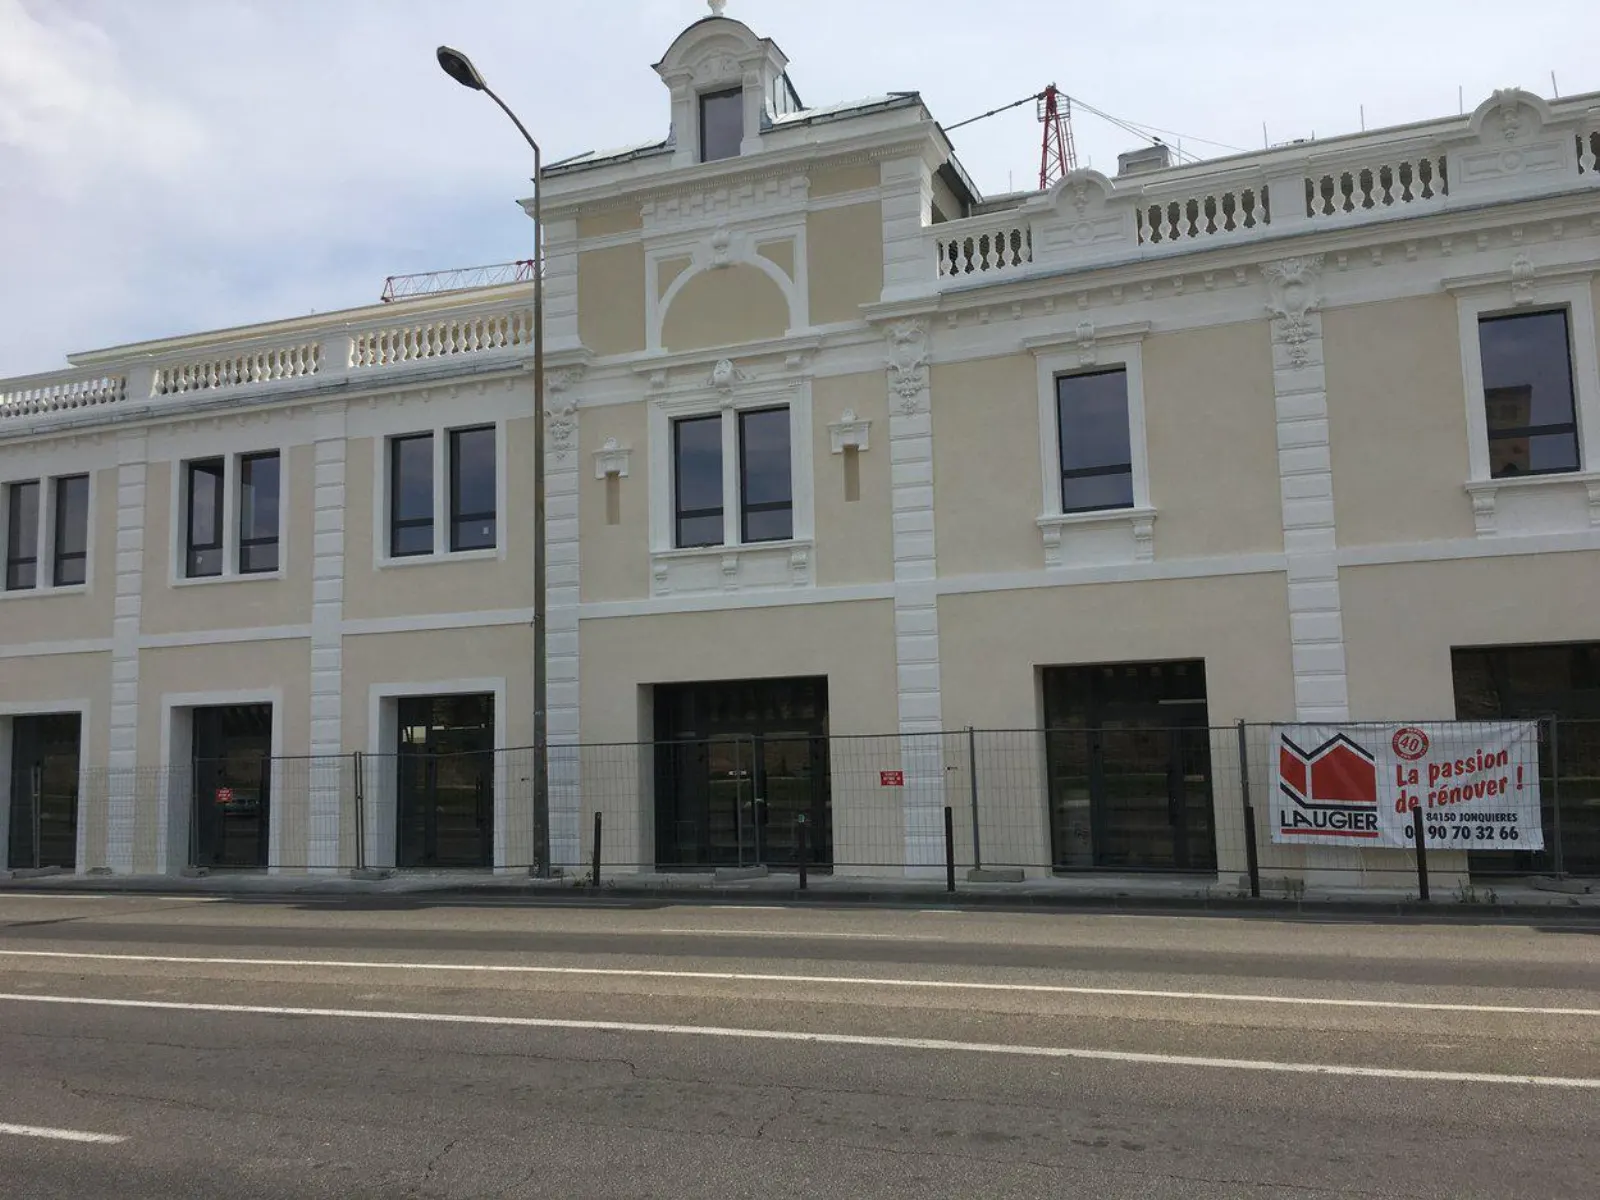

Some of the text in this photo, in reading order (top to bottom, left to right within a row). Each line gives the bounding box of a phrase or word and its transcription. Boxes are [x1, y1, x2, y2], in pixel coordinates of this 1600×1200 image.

[1399, 735, 1420, 752] 40
[1396, 748, 1509, 788] La passion
[1395, 789, 1419, 813] de
[1428, 777, 1508, 808] rénover
[1280, 810, 1378, 831] LAUGIER
[1426, 812, 1518, 823] 84150 JONQUIERES
[1428, 825, 1447, 840] 90
[1452, 825, 1471, 840] 70
[1475, 825, 1495, 840] 32
[1500, 825, 1519, 840] 66
